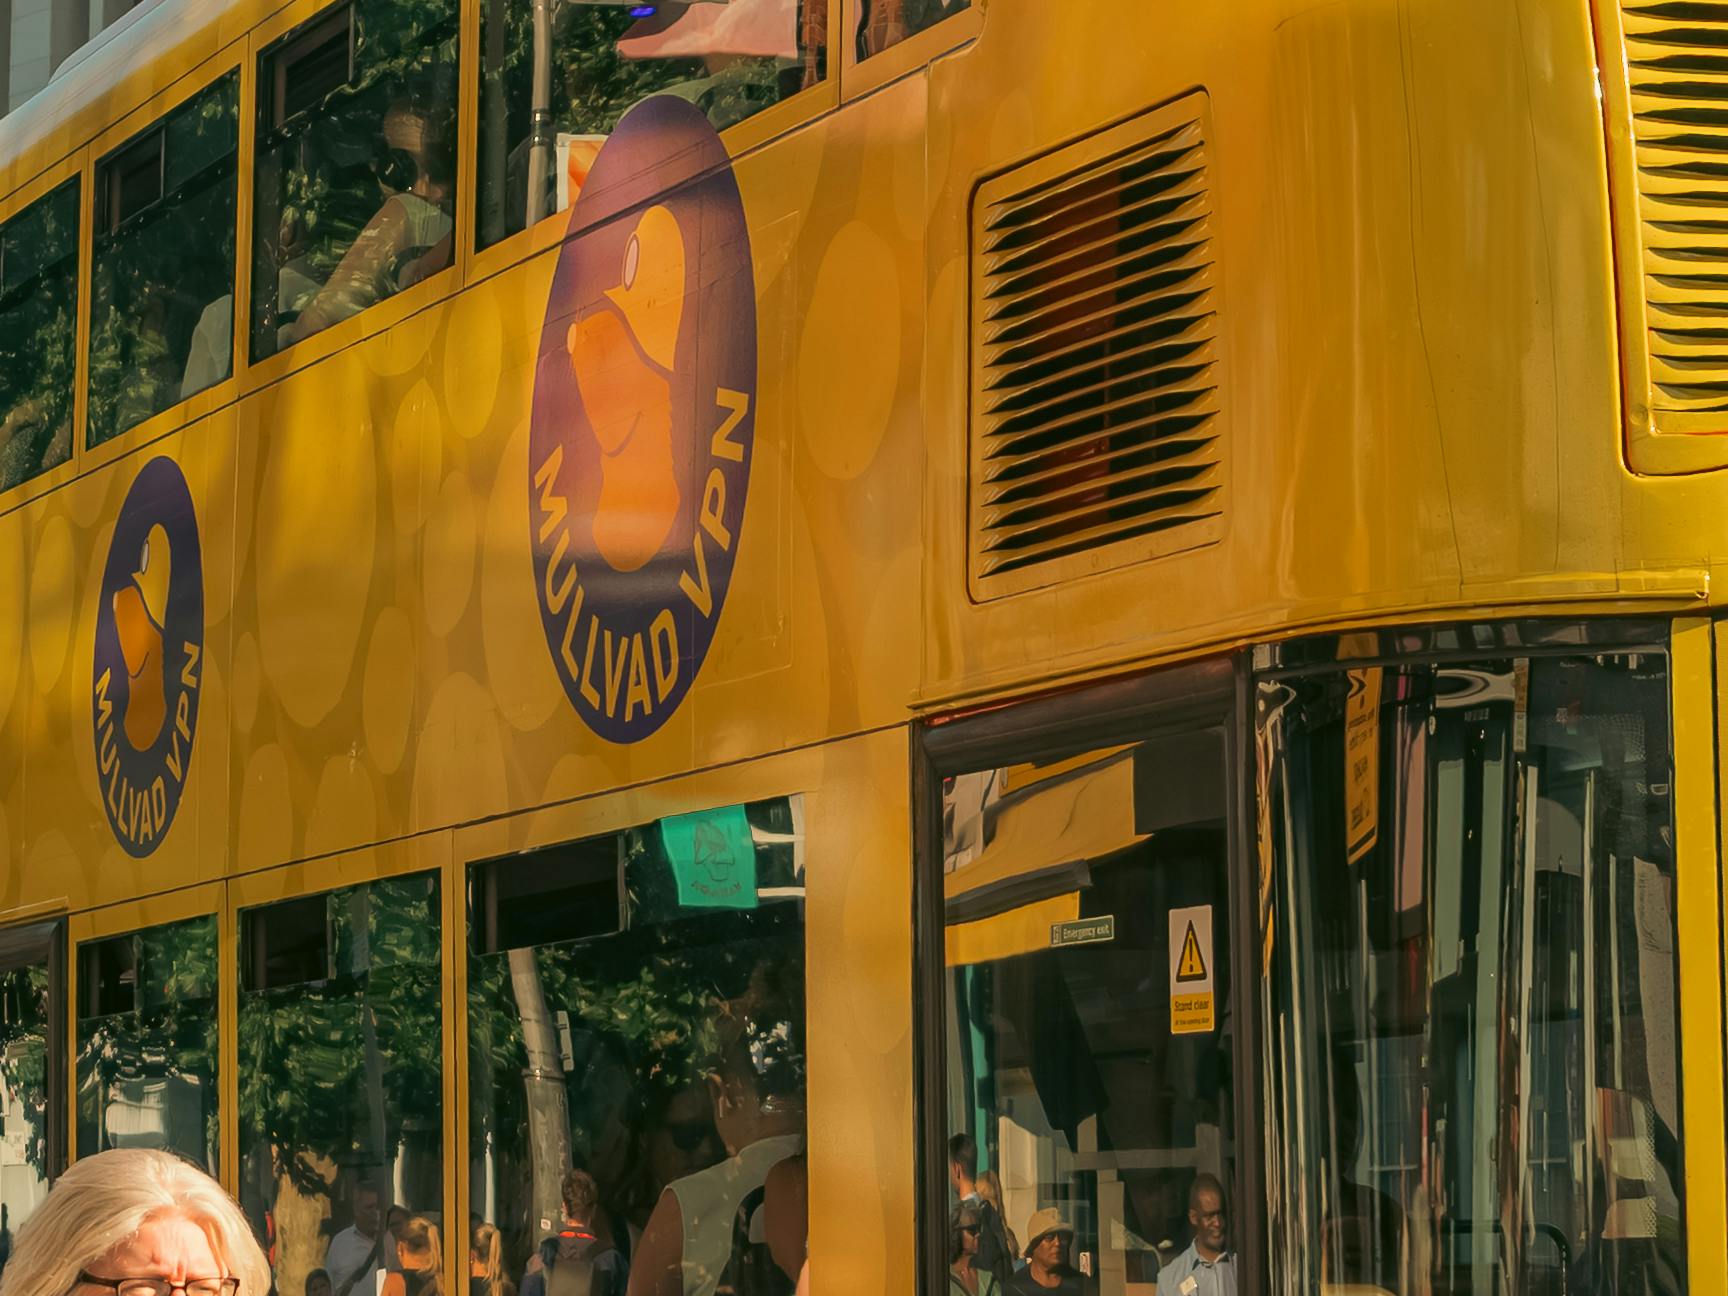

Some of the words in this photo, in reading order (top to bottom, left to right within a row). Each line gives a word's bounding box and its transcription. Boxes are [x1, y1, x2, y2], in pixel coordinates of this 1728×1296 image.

[534, 443, 679, 721] MULLVAD
[679, 387, 749, 619] VPN
[96, 667, 165, 845] MULLVAD
[166, 641, 201, 783] VPN
